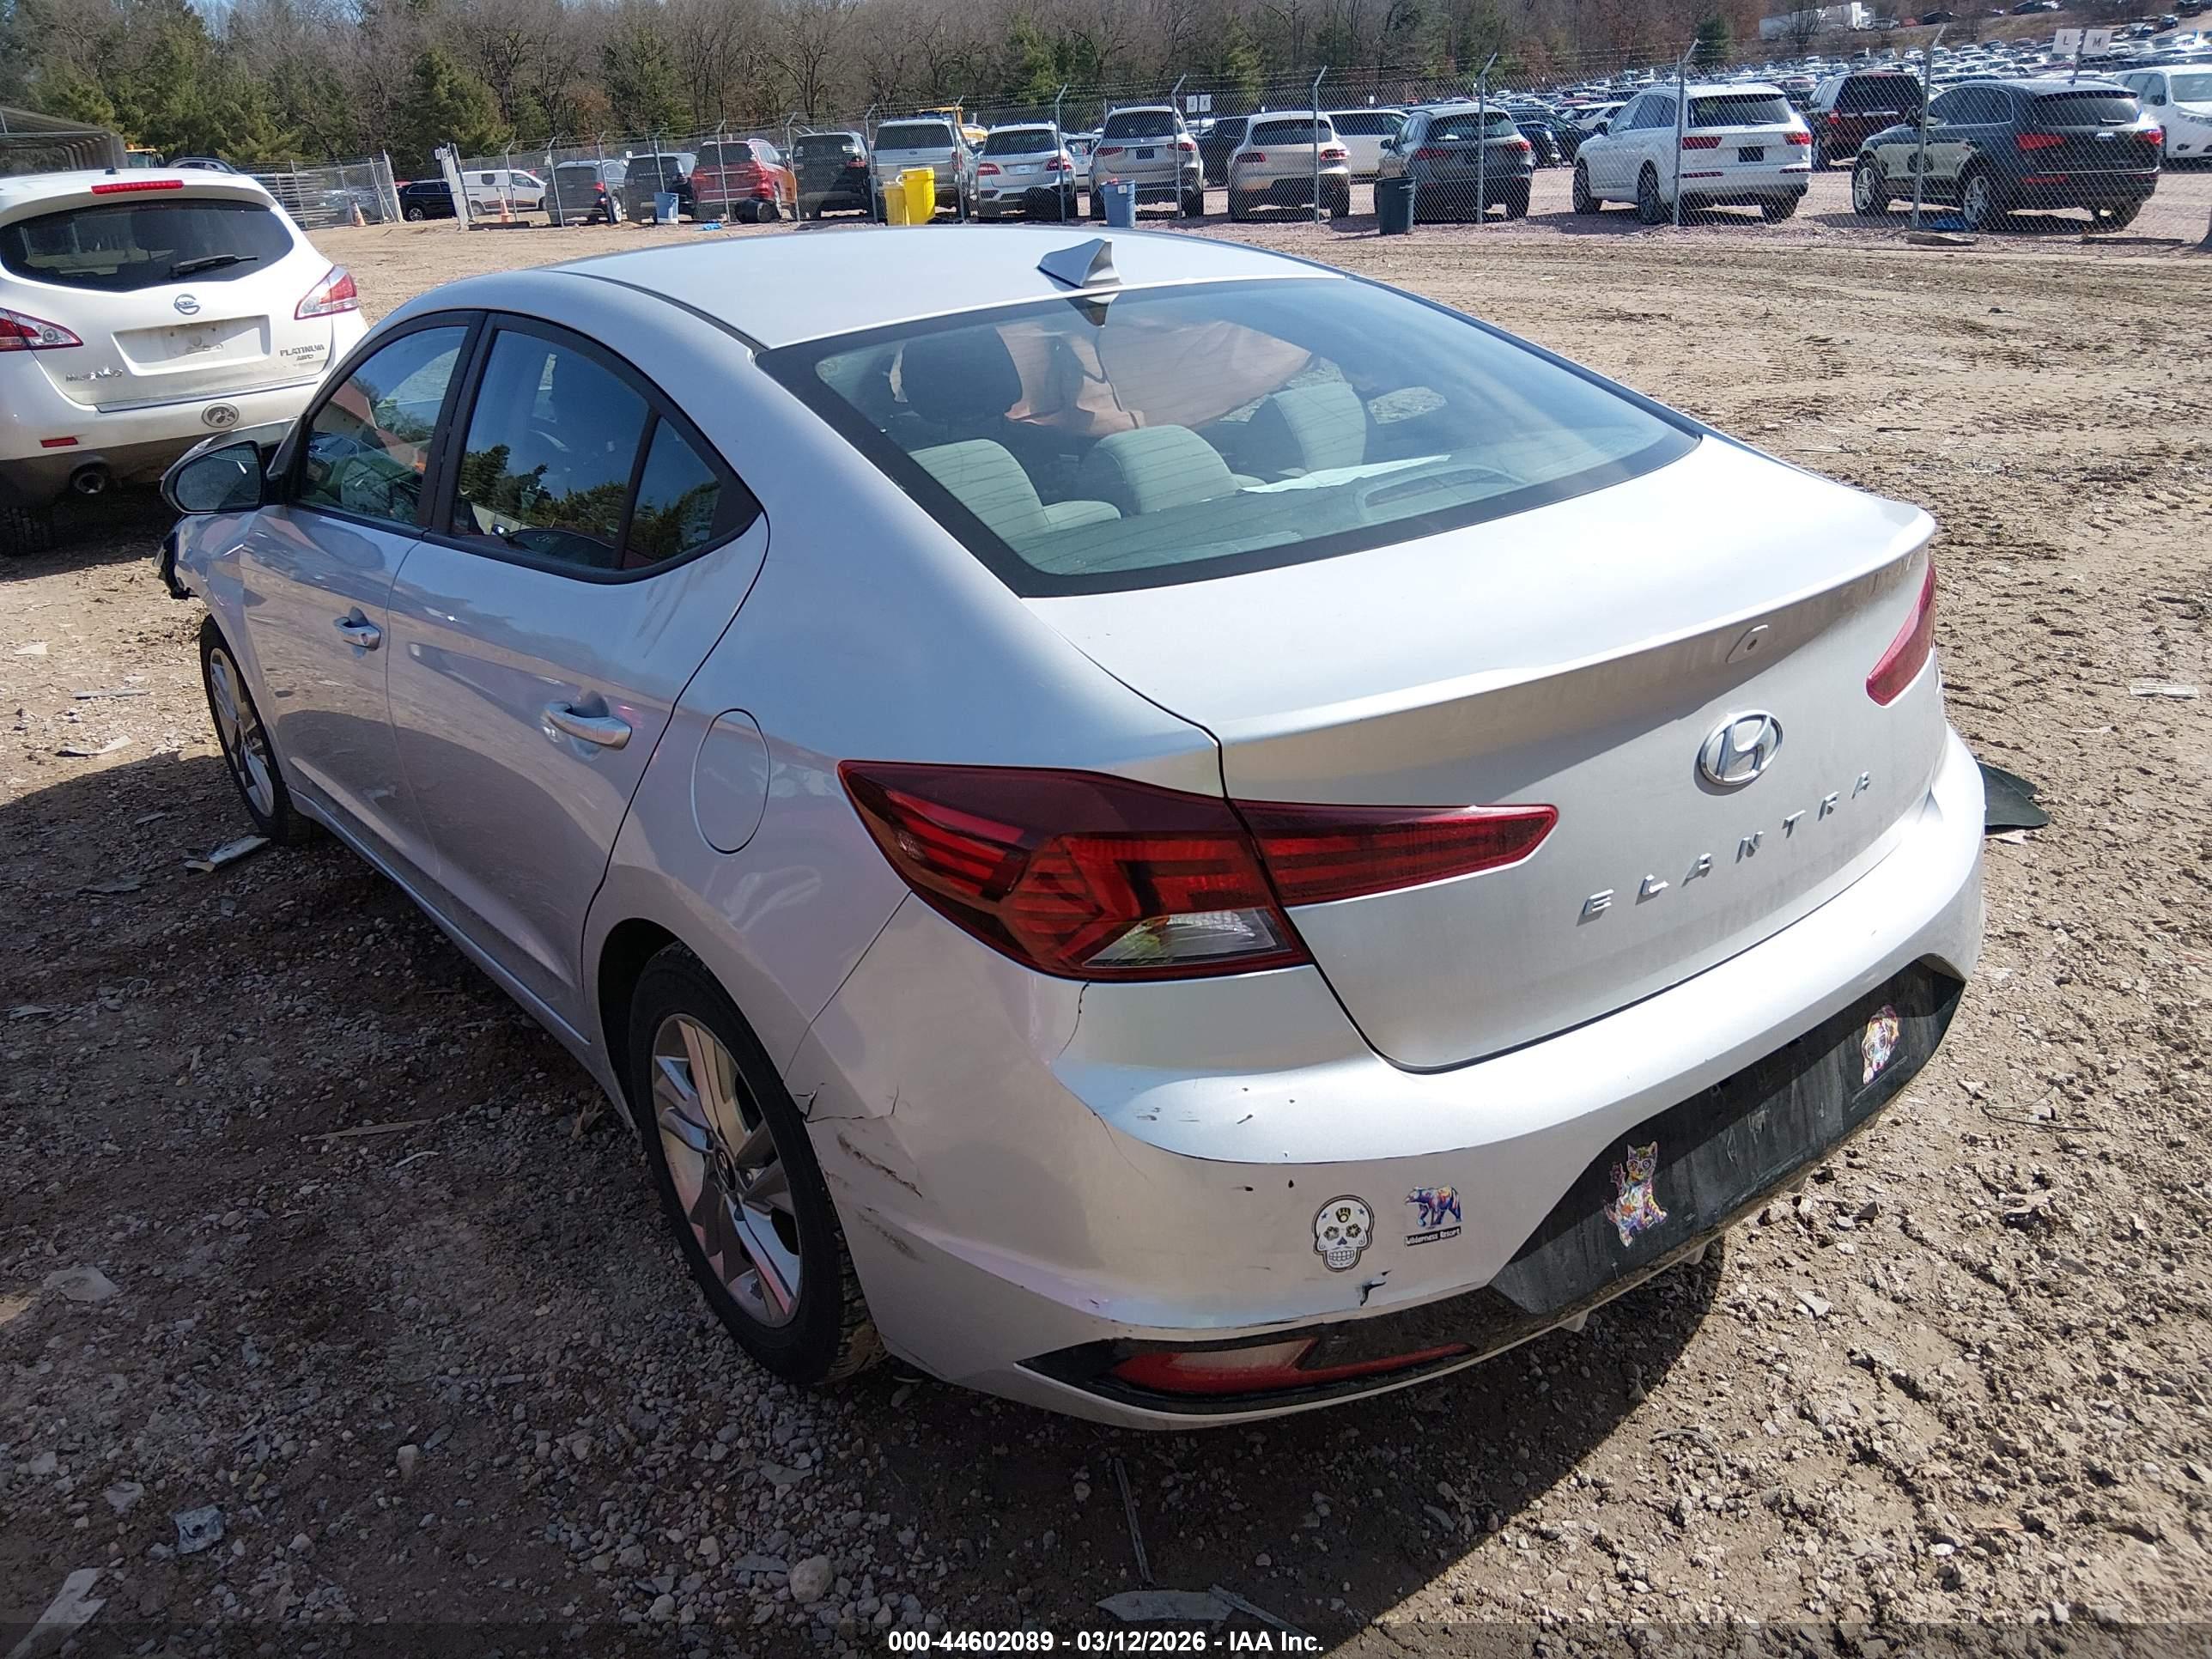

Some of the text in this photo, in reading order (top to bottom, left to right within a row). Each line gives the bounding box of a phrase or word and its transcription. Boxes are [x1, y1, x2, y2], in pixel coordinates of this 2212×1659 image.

[280, 344, 325, 356] PLATINUM
[1581, 770, 1871, 917] ELANTRA
[1405, 1227, 1461, 1245] Wilderness Resort
